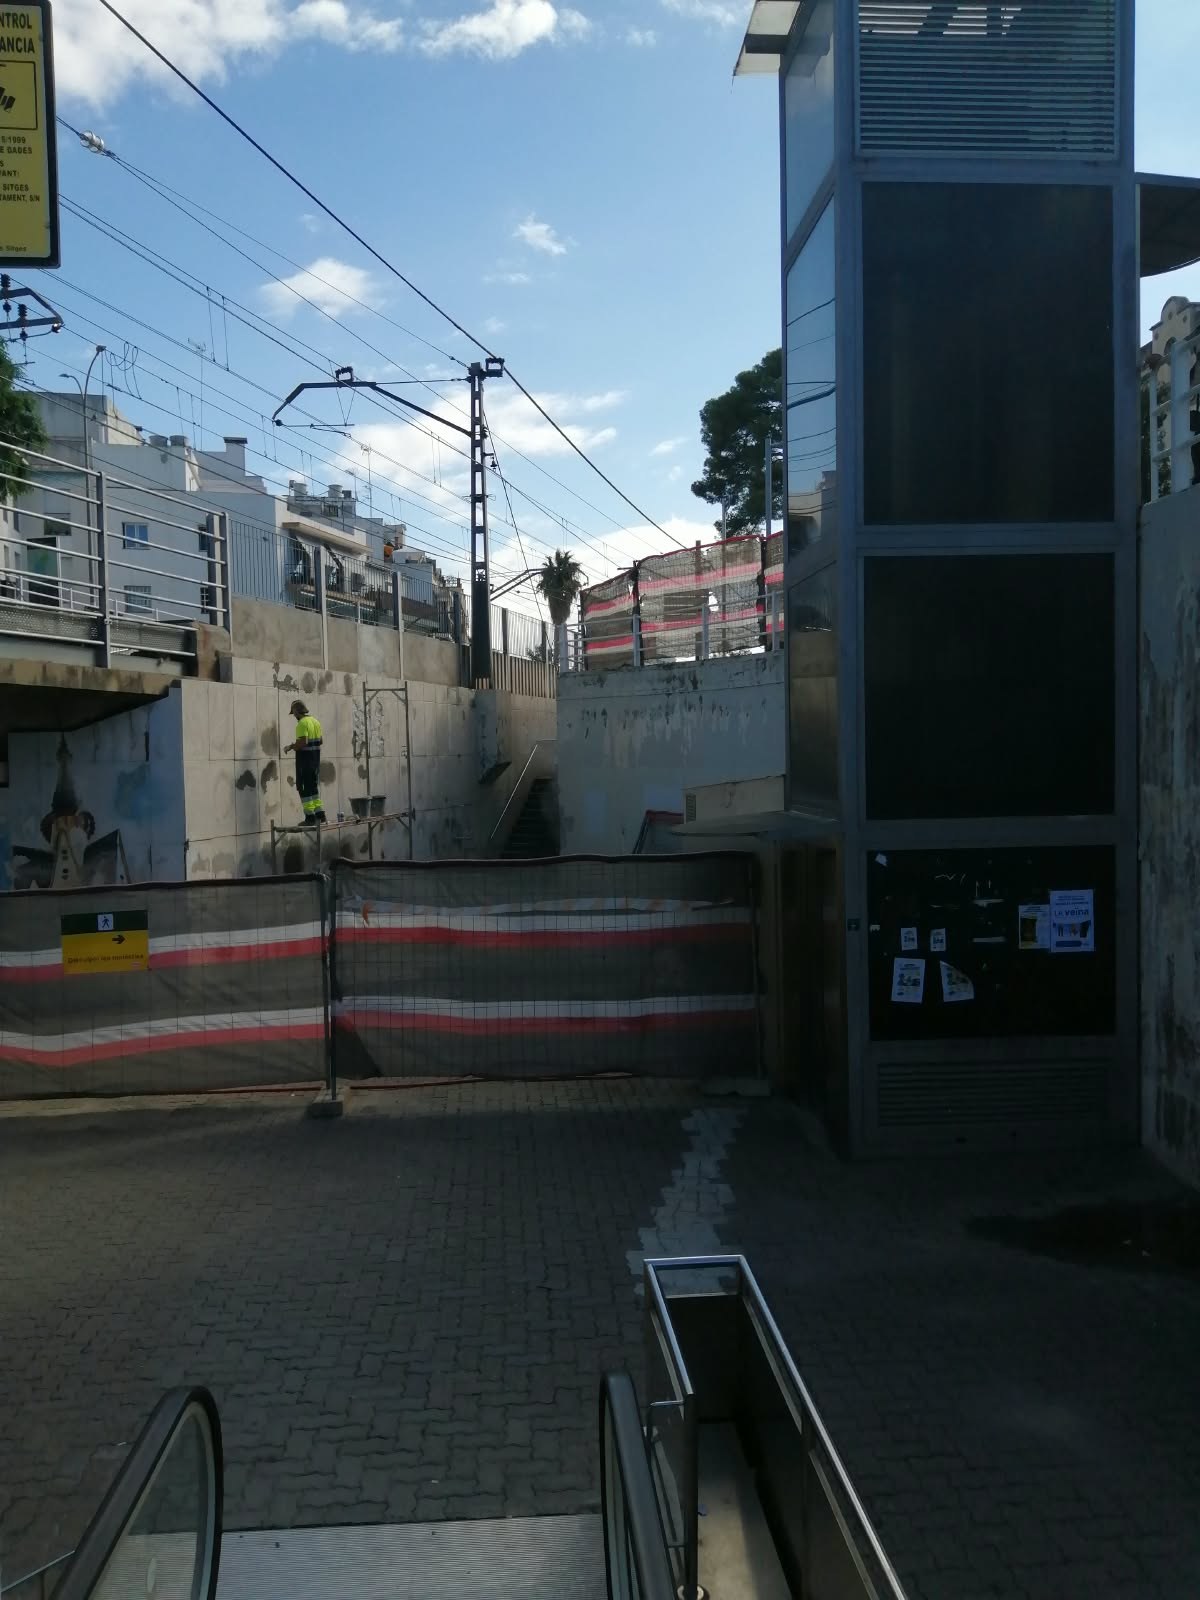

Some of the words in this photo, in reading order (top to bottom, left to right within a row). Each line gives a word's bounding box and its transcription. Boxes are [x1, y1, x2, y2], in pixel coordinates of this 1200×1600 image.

[0, 35, 35, 54] ANCIA
[7, 146, 32, 155] DADES
[2, 183, 29, 192] SITGES
